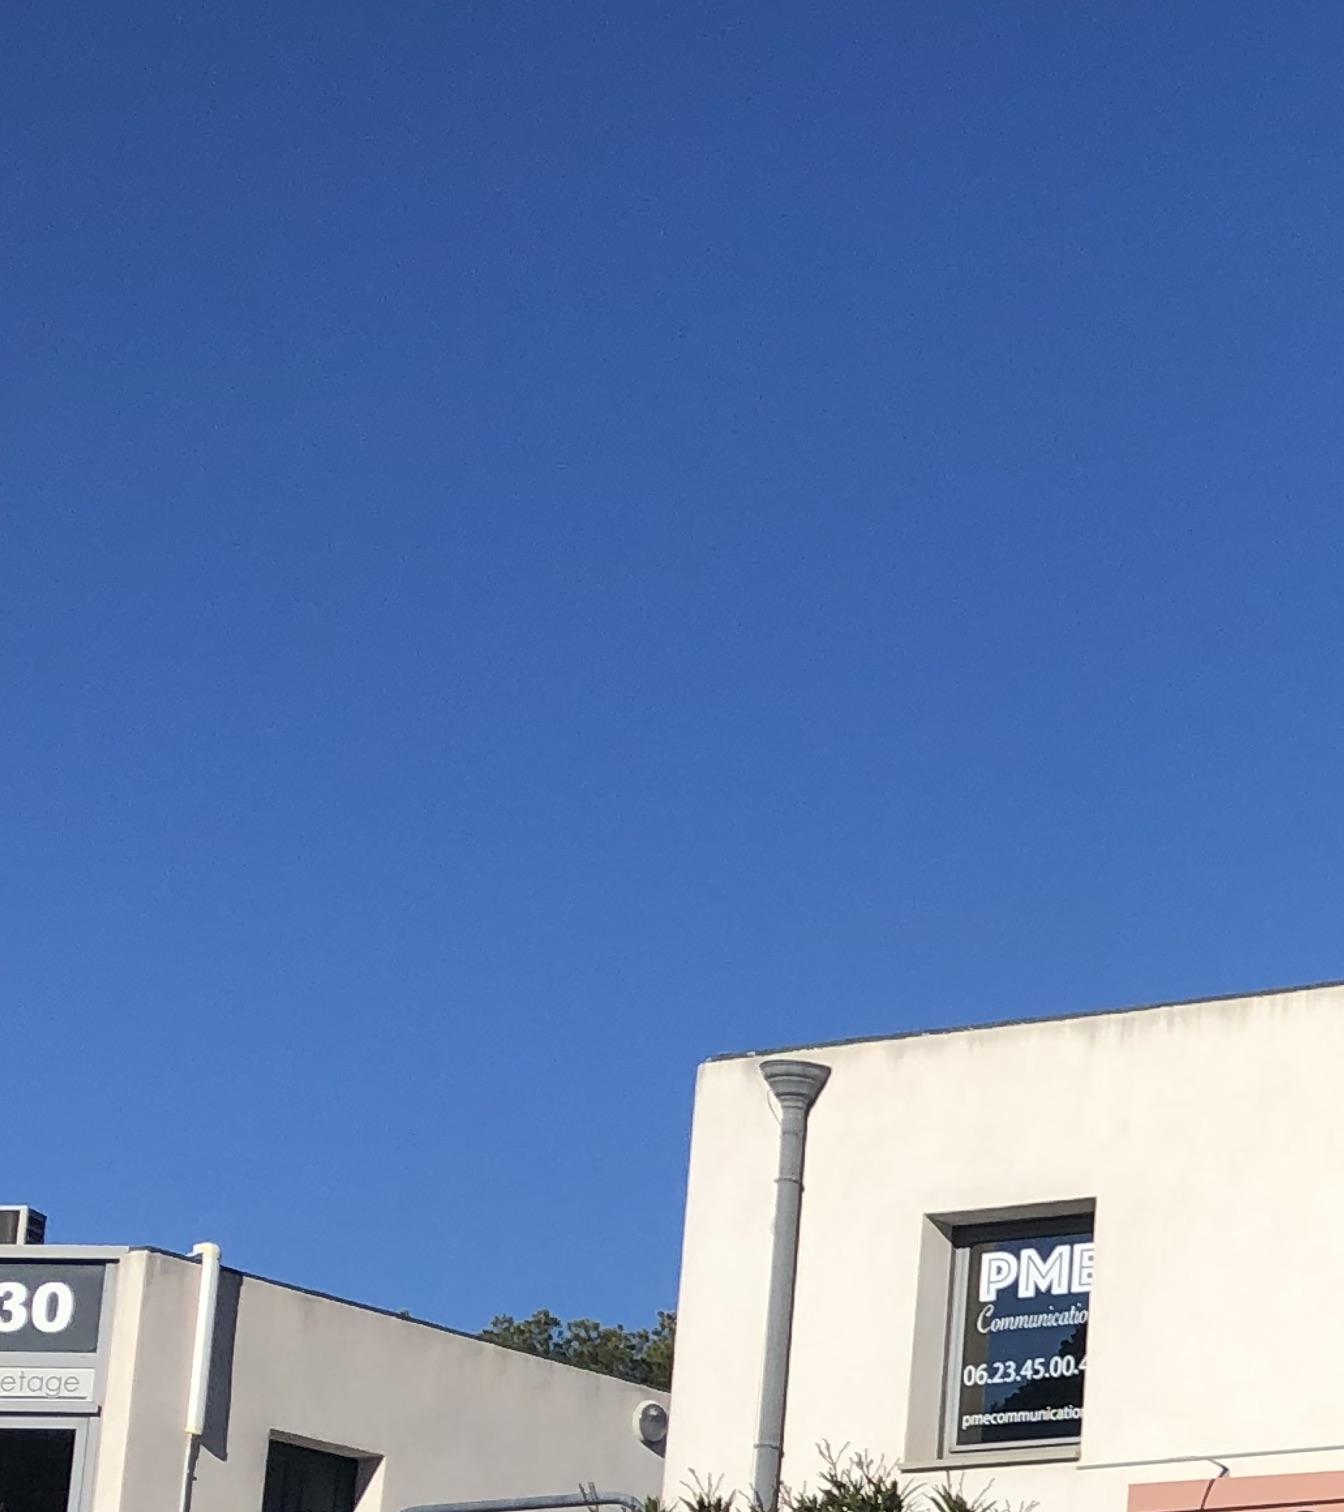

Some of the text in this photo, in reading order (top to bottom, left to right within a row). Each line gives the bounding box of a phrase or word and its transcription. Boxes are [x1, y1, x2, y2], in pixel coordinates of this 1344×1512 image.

[979, 1243, 1095, 1303] PME
[0, 1281, 74, 1333] 30
[976, 1303, 1088, 1334] Communicatio
[963, 1355, 1087, 1386] 06.23.45.00.4
[962, 1406, 1084, 1430] pmecommunicatio
